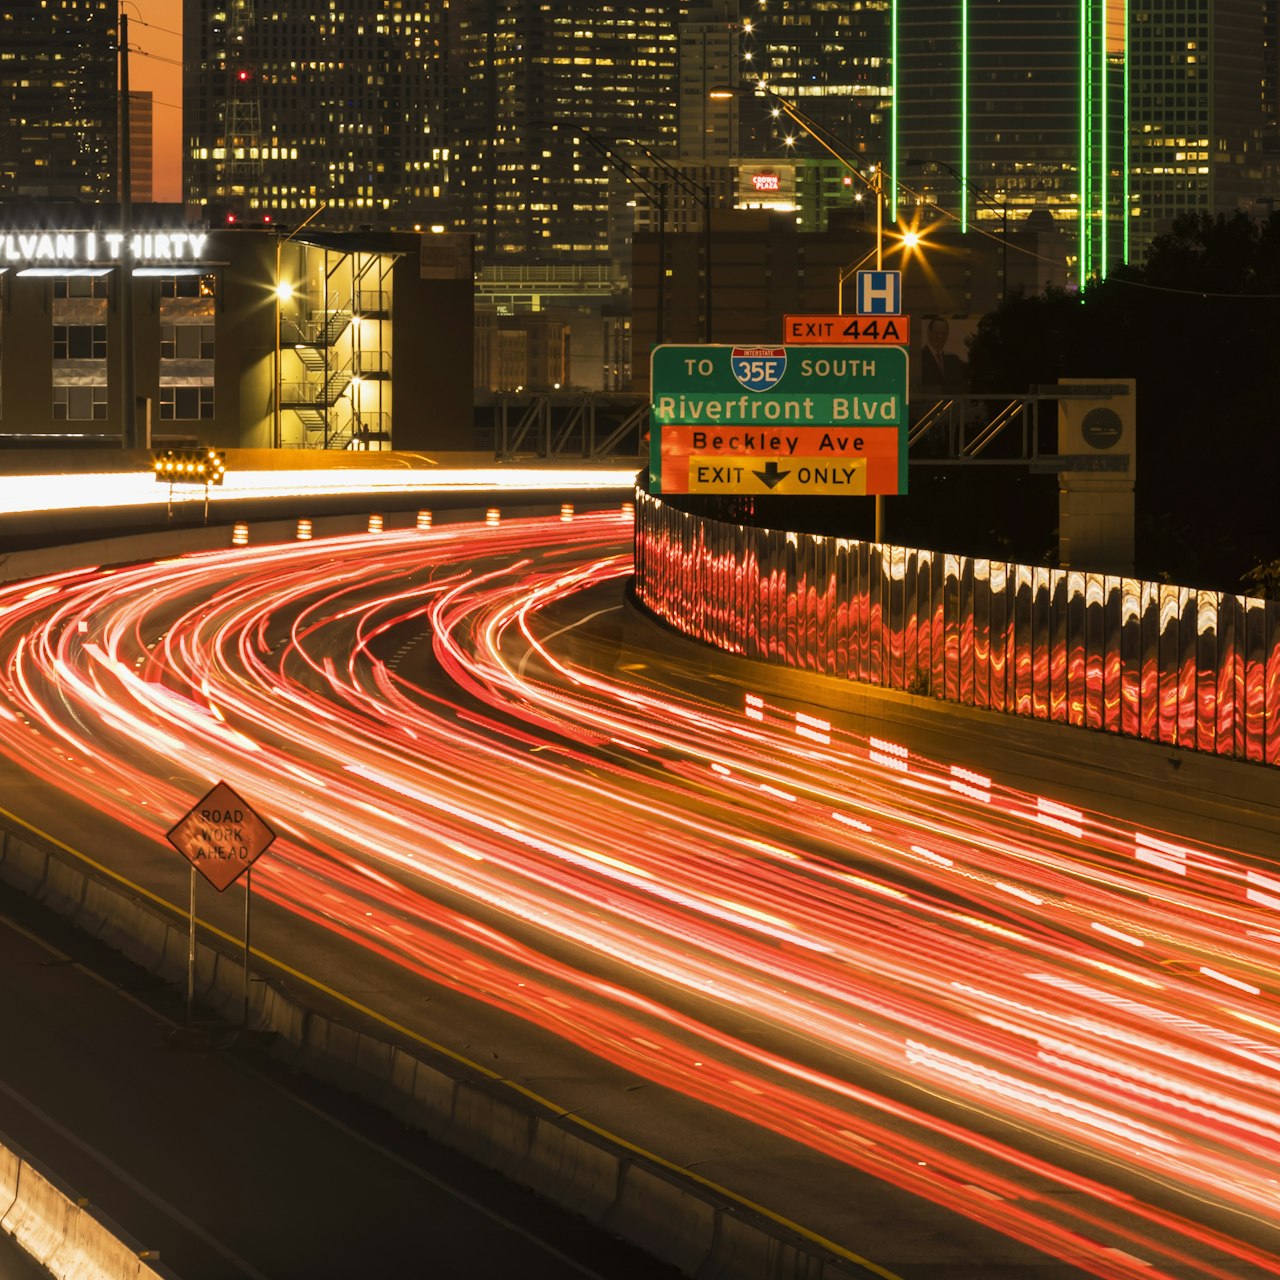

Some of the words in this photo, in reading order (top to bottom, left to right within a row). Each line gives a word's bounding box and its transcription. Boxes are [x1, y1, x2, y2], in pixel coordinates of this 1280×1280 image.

[863, 273, 895, 313] H
[792, 323, 834, 337] EXIT
[842, 320, 900, 340] 44A
[684, 359, 714, 376] TO
[738, 361, 778, 382] 35E
[801, 359, 877, 376] SOUTH
[659, 395, 815, 420] Riverfront
[832, 396, 897, 420] Blvd
[692, 431, 799, 455] Beckley
[818, 433, 865, 451] Ave
[697, 467, 745, 483] EXIT
[797, 468, 857, 484] ONLY
[201, 809, 244, 823] ROAD
[201, 829, 243, 842] WORK
[196, 846, 249, 859] AHEAD
